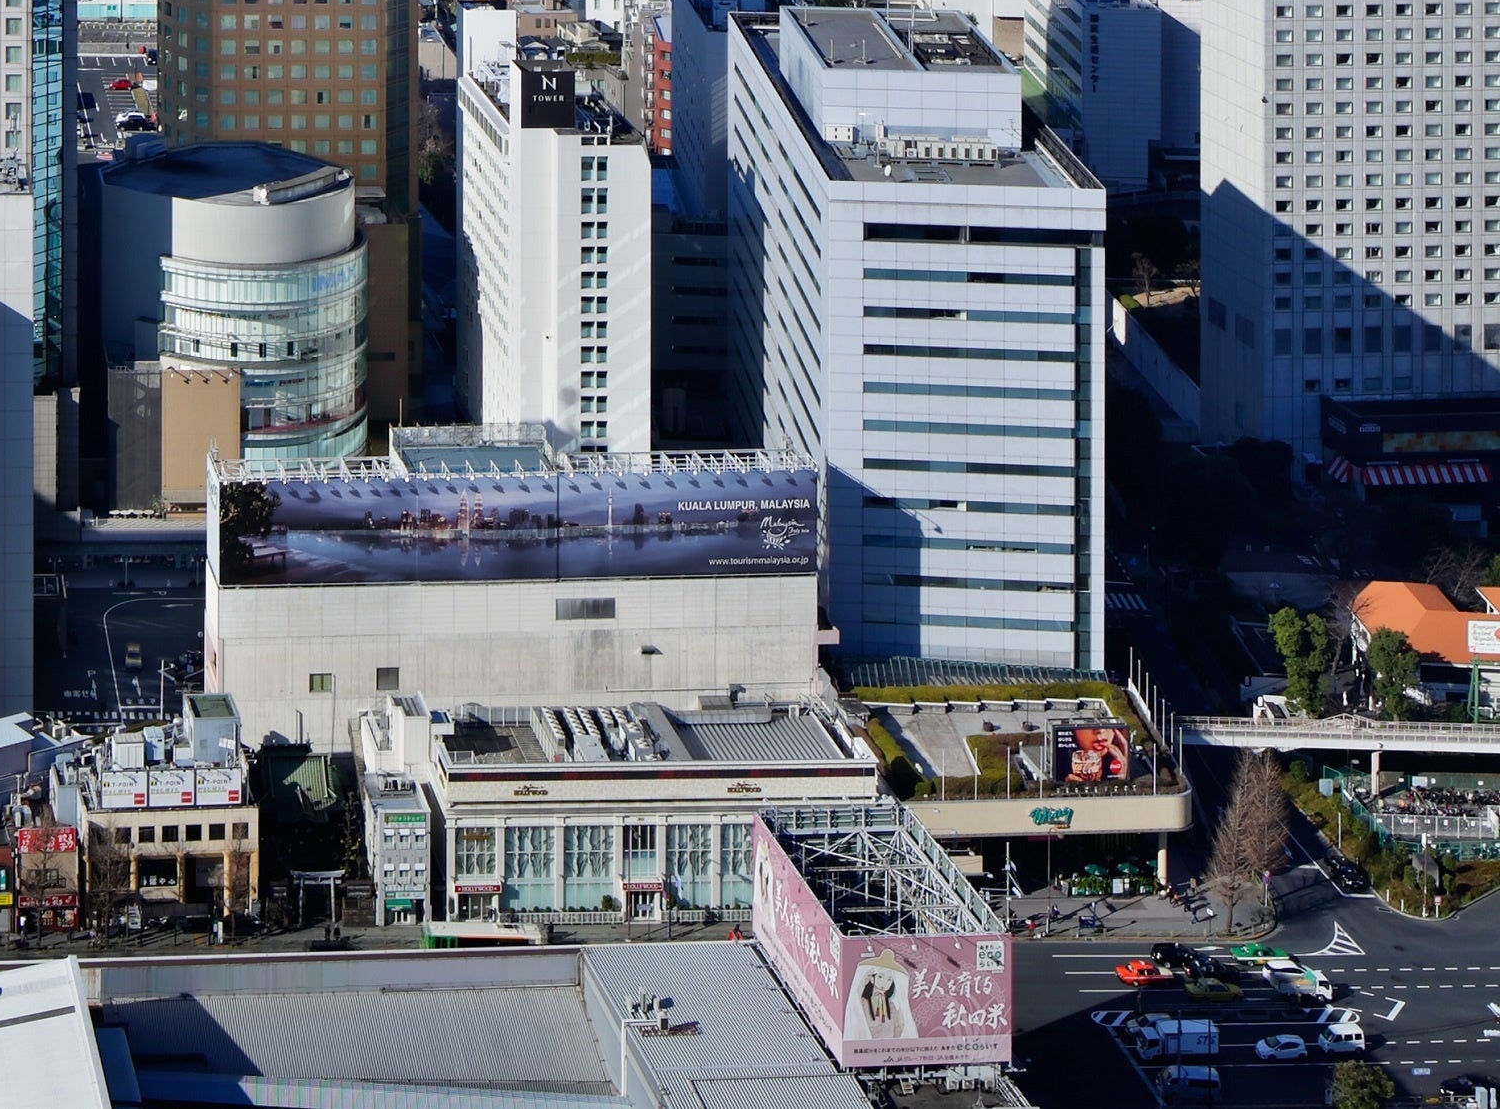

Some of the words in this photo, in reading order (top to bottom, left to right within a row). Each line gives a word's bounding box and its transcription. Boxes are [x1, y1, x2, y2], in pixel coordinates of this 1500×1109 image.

[541, 74, 557, 90] N
[532, 94, 565, 102] TOWER
[678, 501, 712, 511] KUALA
[713, 500, 758, 511] LUMPUR,
[761, 499, 810, 509] MALAYSIA
[760, 515, 805, 532] Malaysia
[708, 556, 809, 566] www.tourismmalaysia.or.jp
[978, 951, 1002, 960] eco
[912, 968, 993, 1000] 美人を育てる
[942, 1001, 1008, 1030] 秋田米
